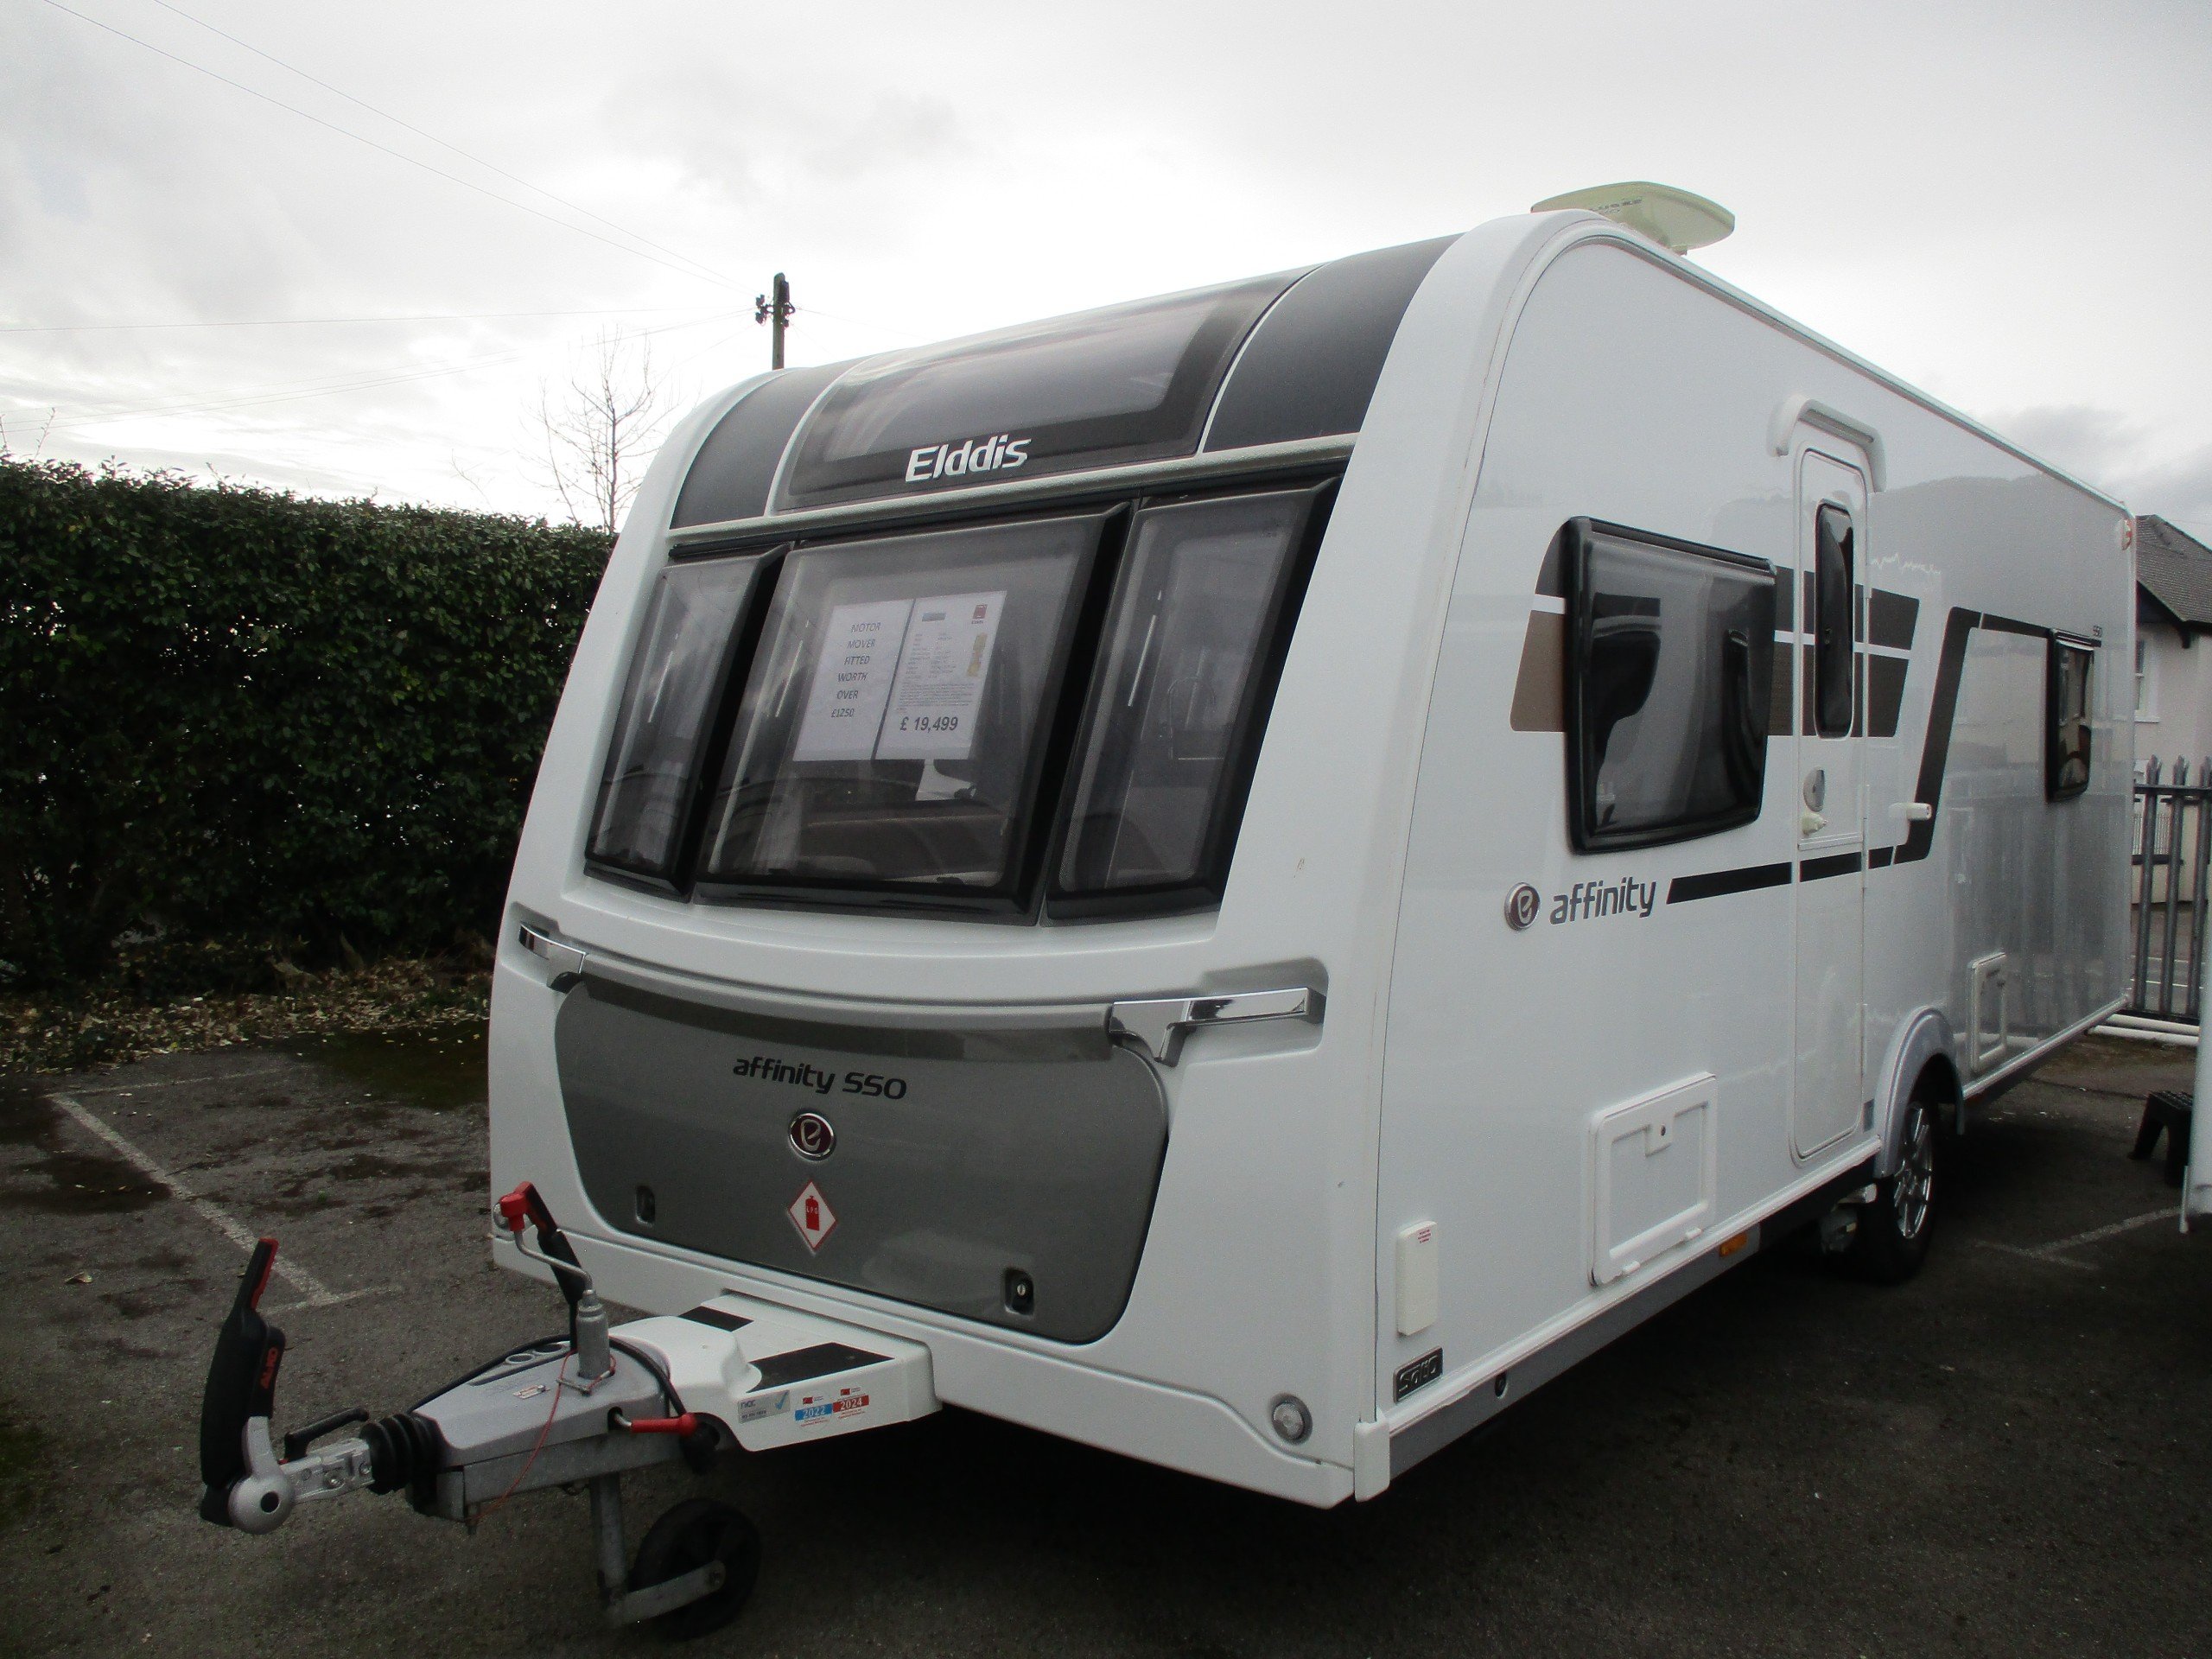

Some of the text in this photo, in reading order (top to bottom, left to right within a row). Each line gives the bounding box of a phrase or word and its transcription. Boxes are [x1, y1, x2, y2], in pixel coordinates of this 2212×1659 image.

[906, 434, 1032, 482] Elddis
[850, 621, 881, 633] MOTOR
[847, 639, 876, 650] MOVER
[843, 655, 870, 665] FITTED
[837, 671, 868, 683] WORTH
[836, 690, 858, 700] OVER
[830, 708, 855, 718] £1250
[899, 715, 958, 733] £ 19,499
[1549, 876, 1656, 925] affinity
[733, 1056, 836, 1095] affinity
[840, 1397, 862, 1410] 2024
[803, 1405, 826, 1419] 2022
